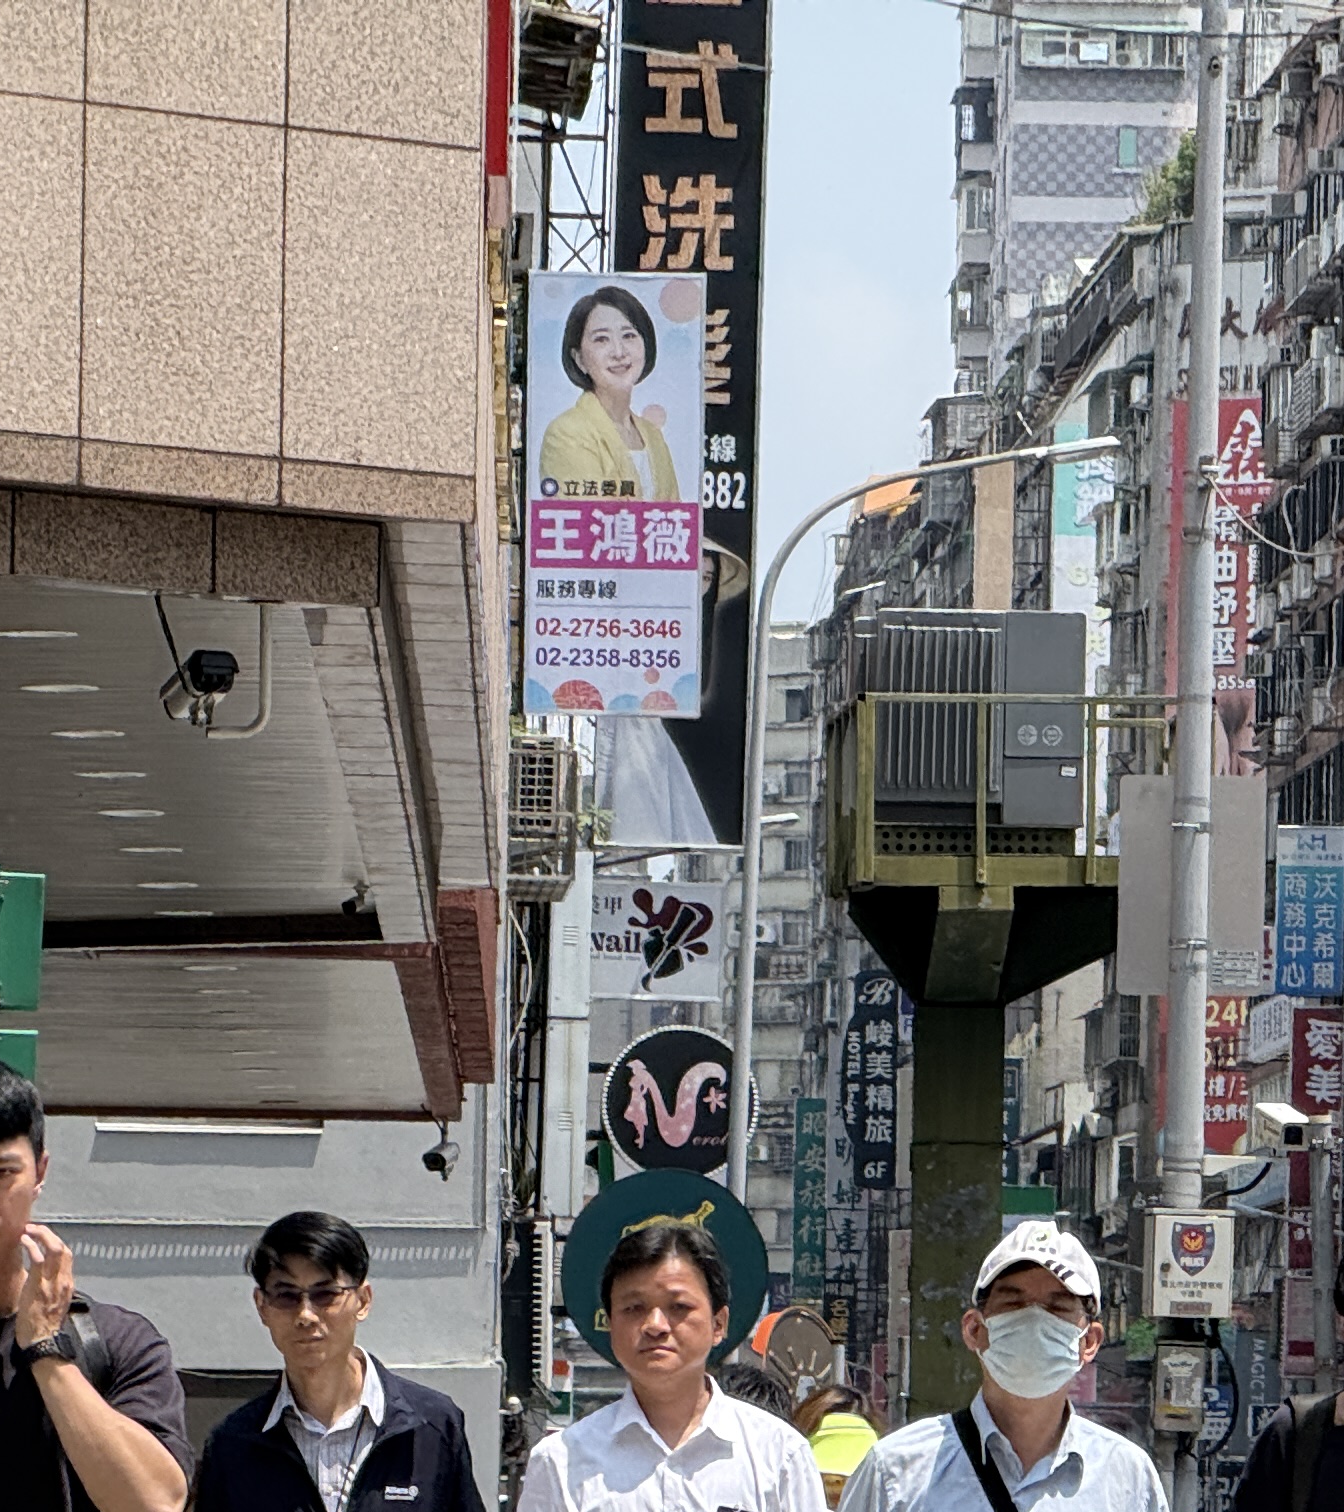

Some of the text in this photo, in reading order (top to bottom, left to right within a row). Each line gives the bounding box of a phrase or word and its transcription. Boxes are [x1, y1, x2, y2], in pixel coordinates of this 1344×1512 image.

[563, 479, 636, 498] 立法委員
[535, 508, 692, 564] 王鴻薇
[535, 578, 618, 600] 服務專線
[535, 617, 682, 640] 02-2756-3646
[535, 646, 682, 670] 02-2358-8356
[1280, 871, 1308, 990] 商務中心
[1312, 872, 1338, 989] 沃克希爾
[863, 1161, 889, 1180] 6F
